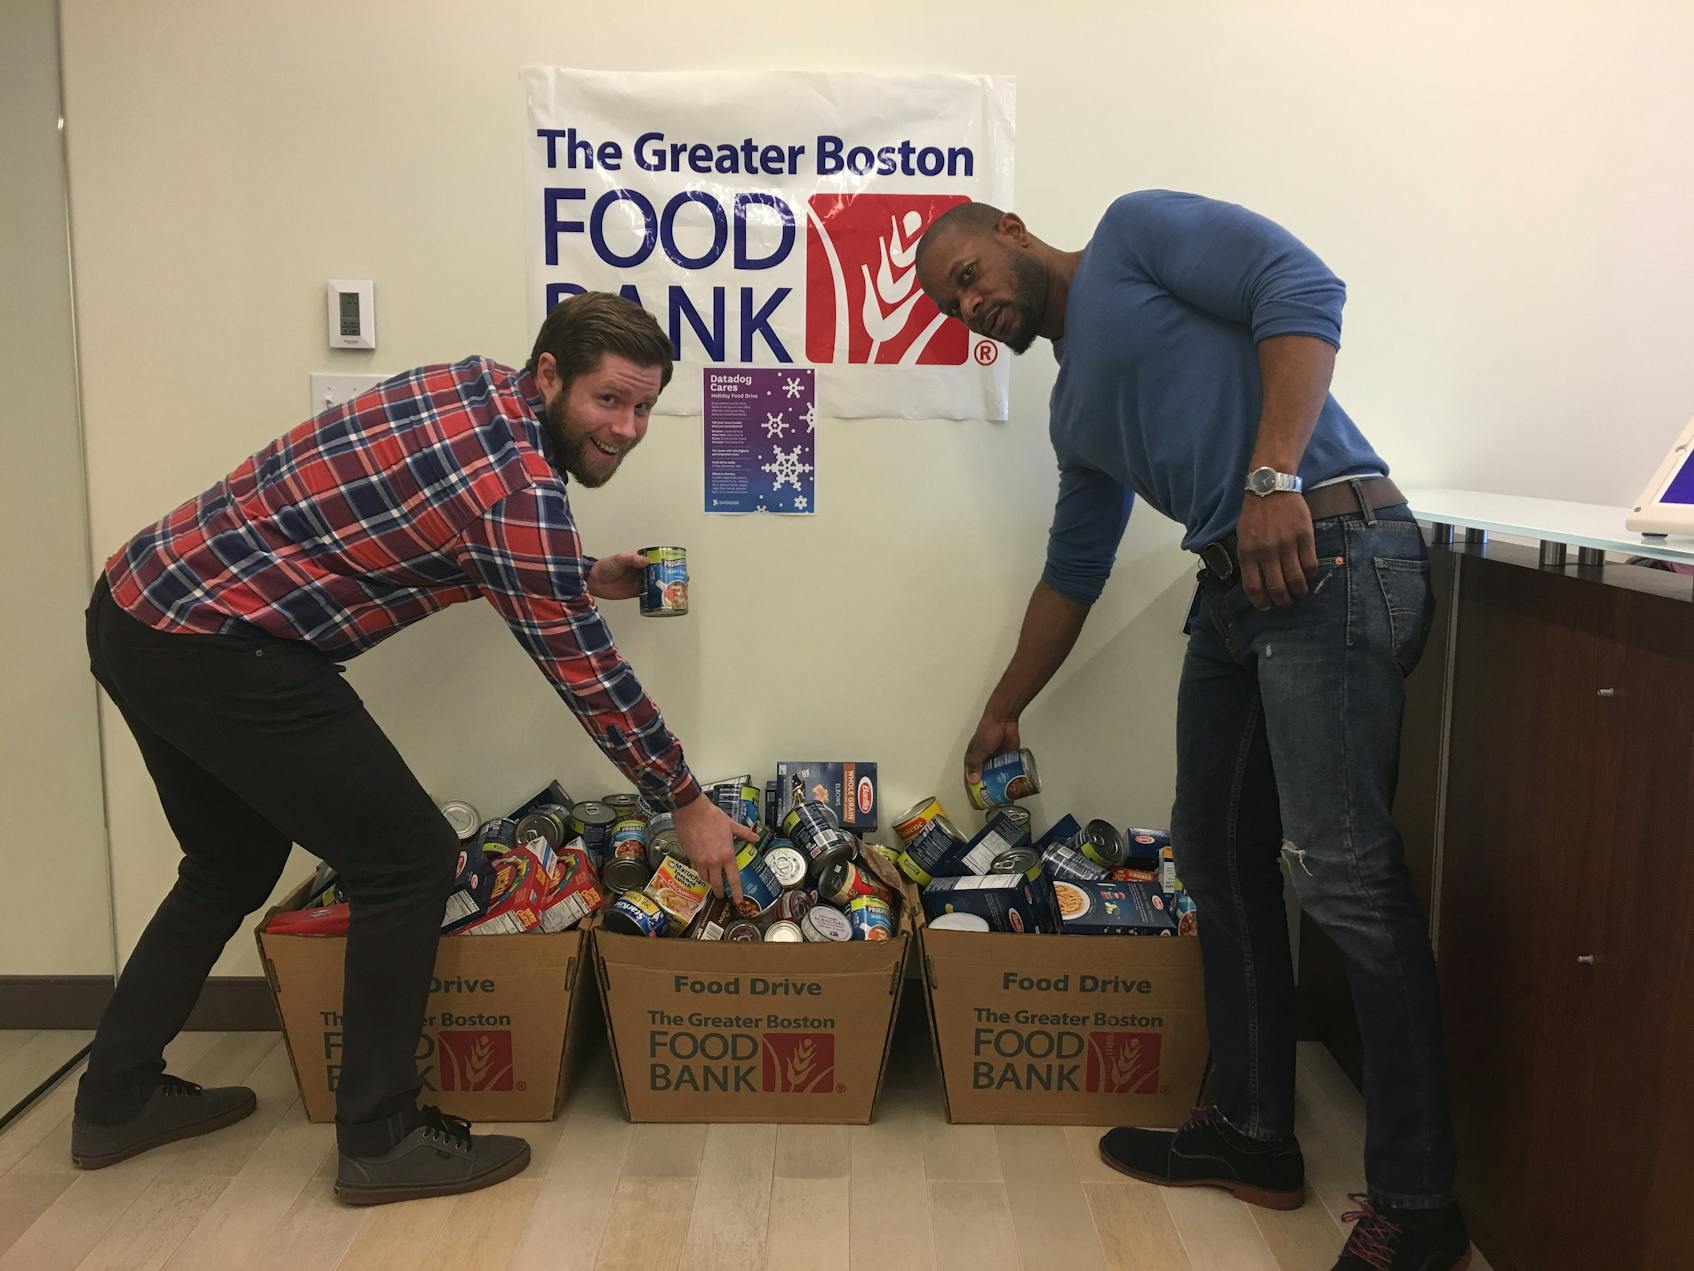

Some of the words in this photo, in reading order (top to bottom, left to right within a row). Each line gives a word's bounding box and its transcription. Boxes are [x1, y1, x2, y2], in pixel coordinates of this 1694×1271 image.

[537, 128, 623, 171] The
[634, 132, 805, 175] Greater
[815, 135, 975, 177] Boston
[543, 187, 796, 271] FOOD
[710, 374, 752, 385] Datadog
[710, 383, 738, 392] Cares
[674, 862, 706, 888] Maruchan
[674, 975, 740, 995] Food
[750, 978, 822, 996] Drive
[1002, 972, 1069, 993] Food
[1079, 975, 1152, 994] Drive
[319, 1011, 343, 1027] Th
[440, 1012, 511, 1027] Boston
[647, 1010, 684, 1027] The
[687, 1012, 762, 1029] Greater
[766, 1015, 835, 1029] Boston
[973, 1008, 1011, 1024] The
[1014, 1009, 1089, 1026] Greater
[1094, 1012, 1163, 1028] Boston
[324, 1031, 435, 1061] FD
[649, 1030, 758, 1062] FOOD
[974, 1028, 1084, 1060] FOOD
[650, 1063, 757, 1093] BANK
[972, 1061, 1081, 1092] BANK
